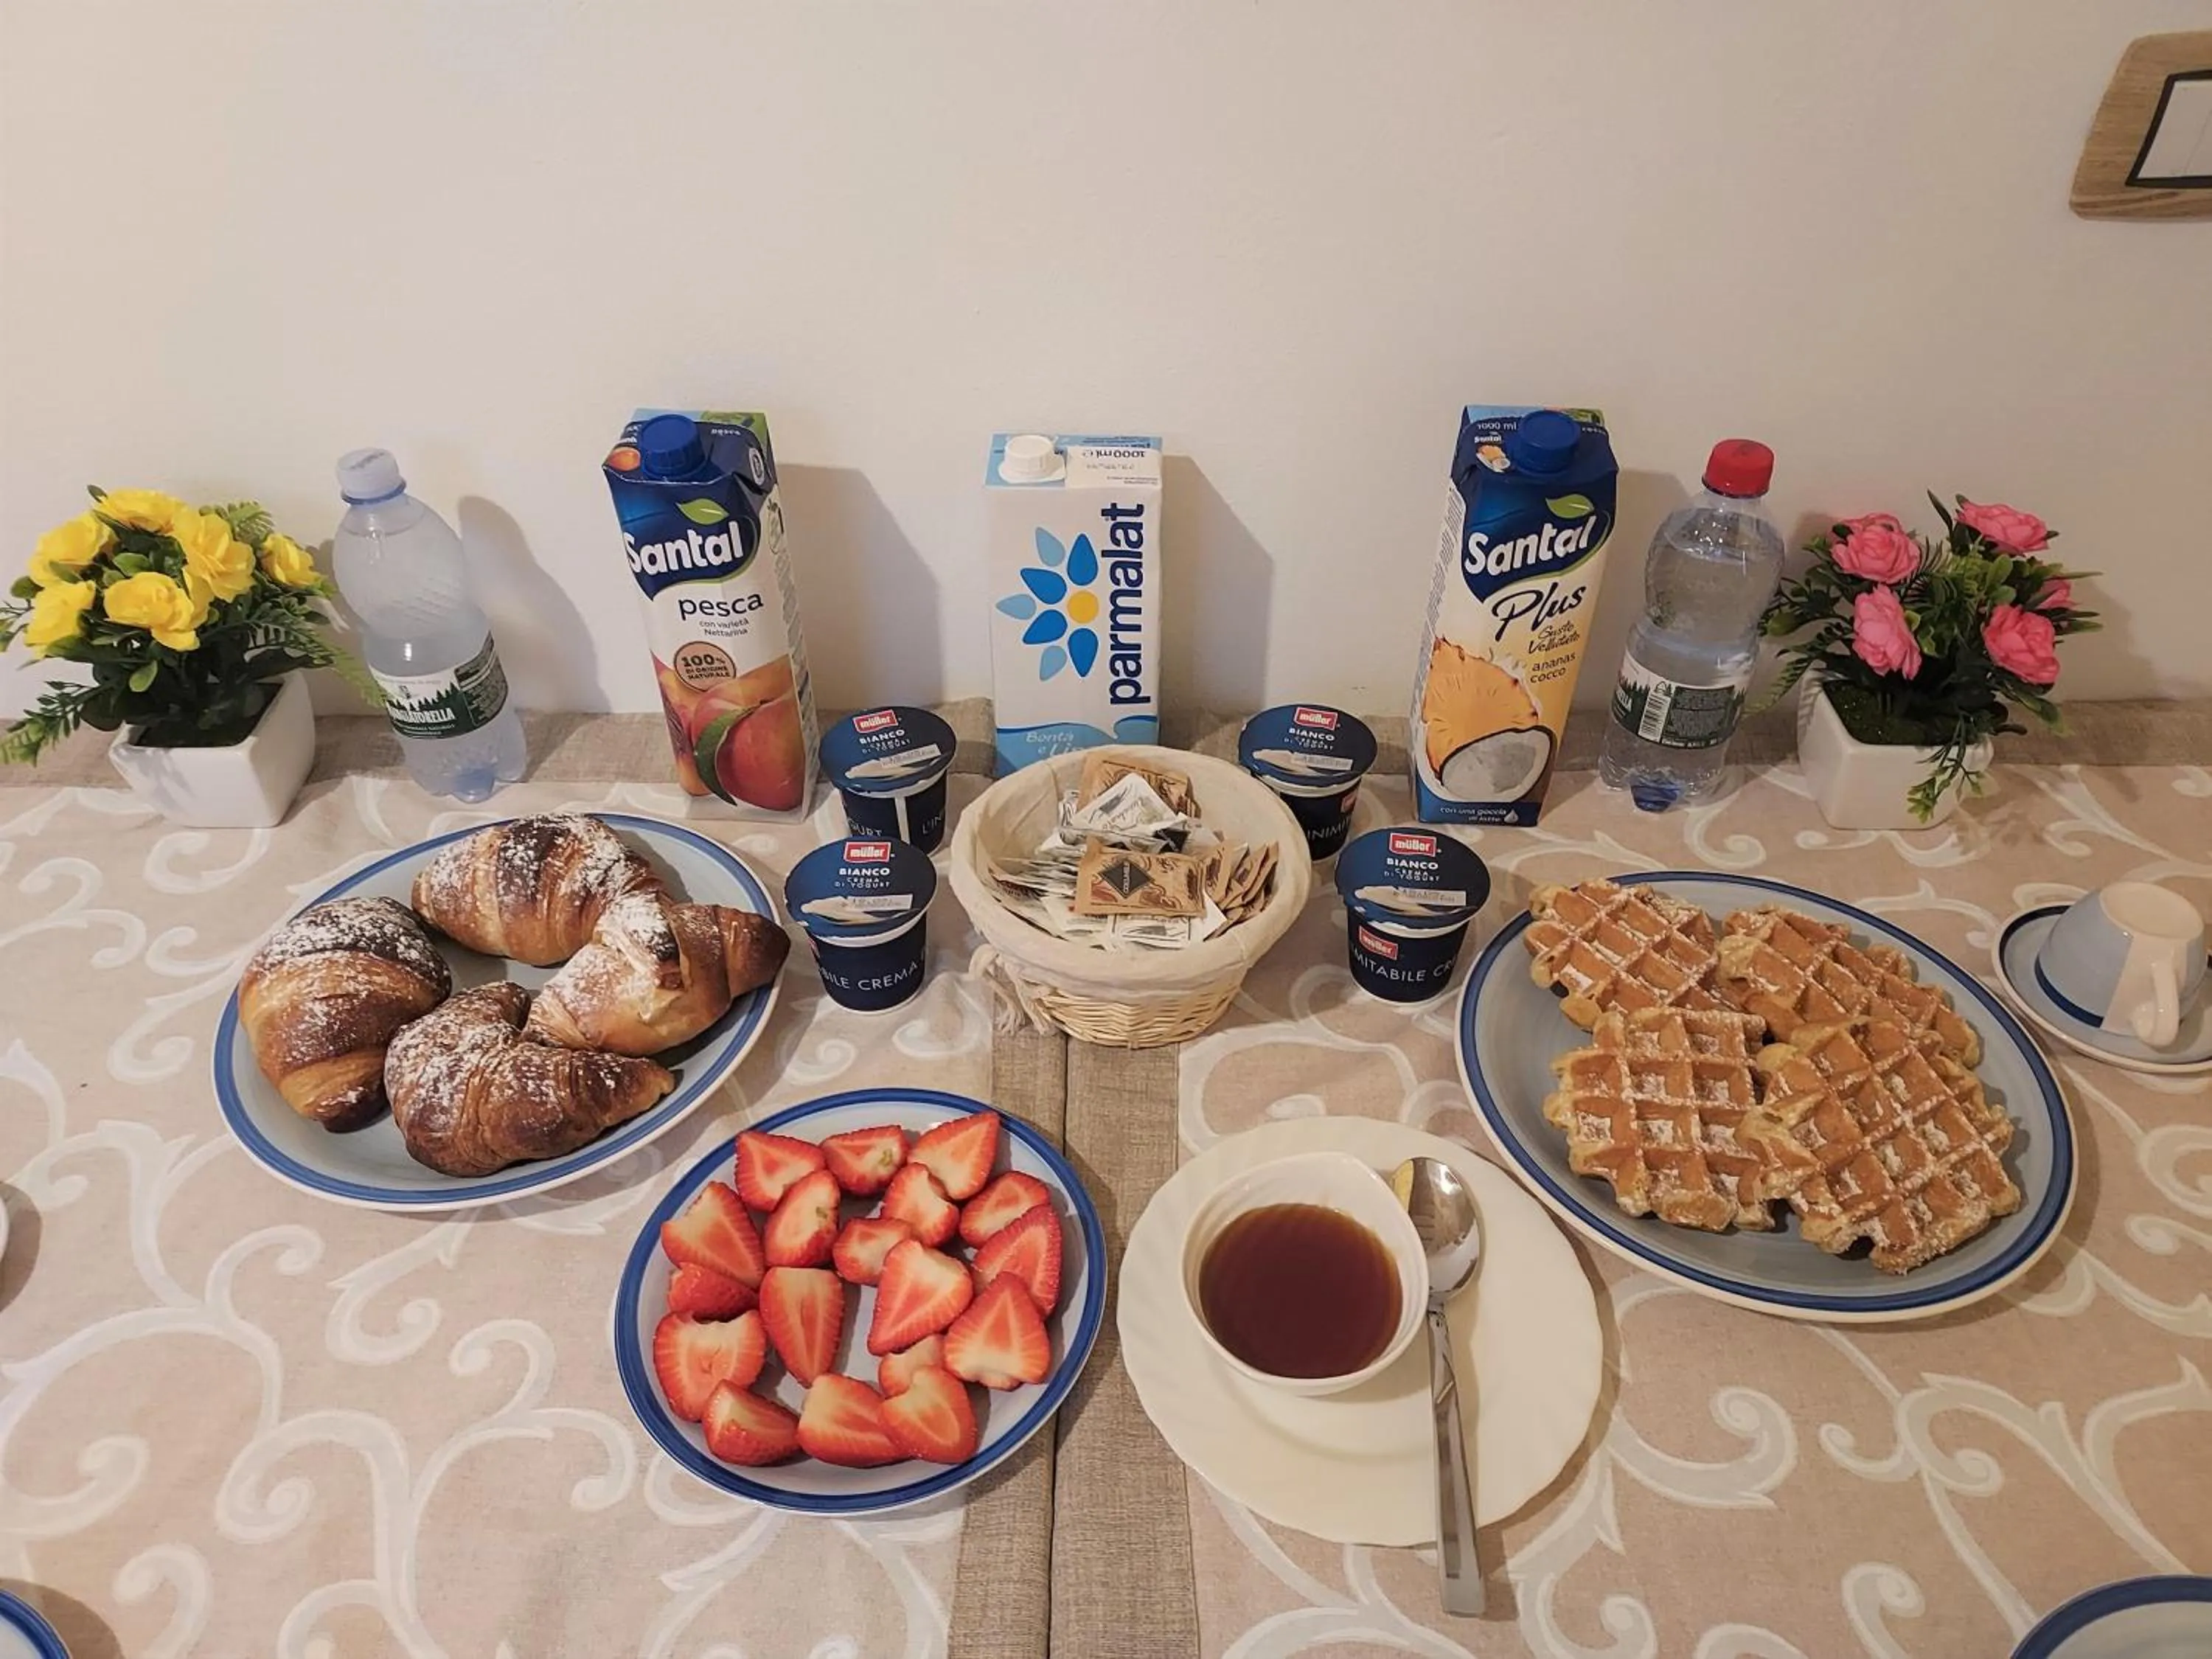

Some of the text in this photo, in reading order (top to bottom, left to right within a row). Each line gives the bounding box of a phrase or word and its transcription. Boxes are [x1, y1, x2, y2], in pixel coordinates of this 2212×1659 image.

[1503, 422, 1517, 431] ml
[622, 519, 744, 576] Santal
[1464, 515, 1597, 576] Santal
[678, 593, 765, 621] pesca
[1101, 502, 1151, 705] parmalat
[1491, 582, 1587, 642] Plus
[1531, 653, 1576, 672] ananas
[1530, 667, 1567, 684] cocco
[860, 715, 891, 728] müller
[1299, 712, 1332, 725] müller
[859, 729, 905, 745] BIANCO
[1288, 727, 1335, 742] BIANCO
[849, 846, 886, 858] müller
[1394, 838, 1432, 852] müller
[838, 867, 891, 876] BIANCO
[1385, 857, 1439, 870] BIANCO
[858, 960, 918, 991] CREMA
